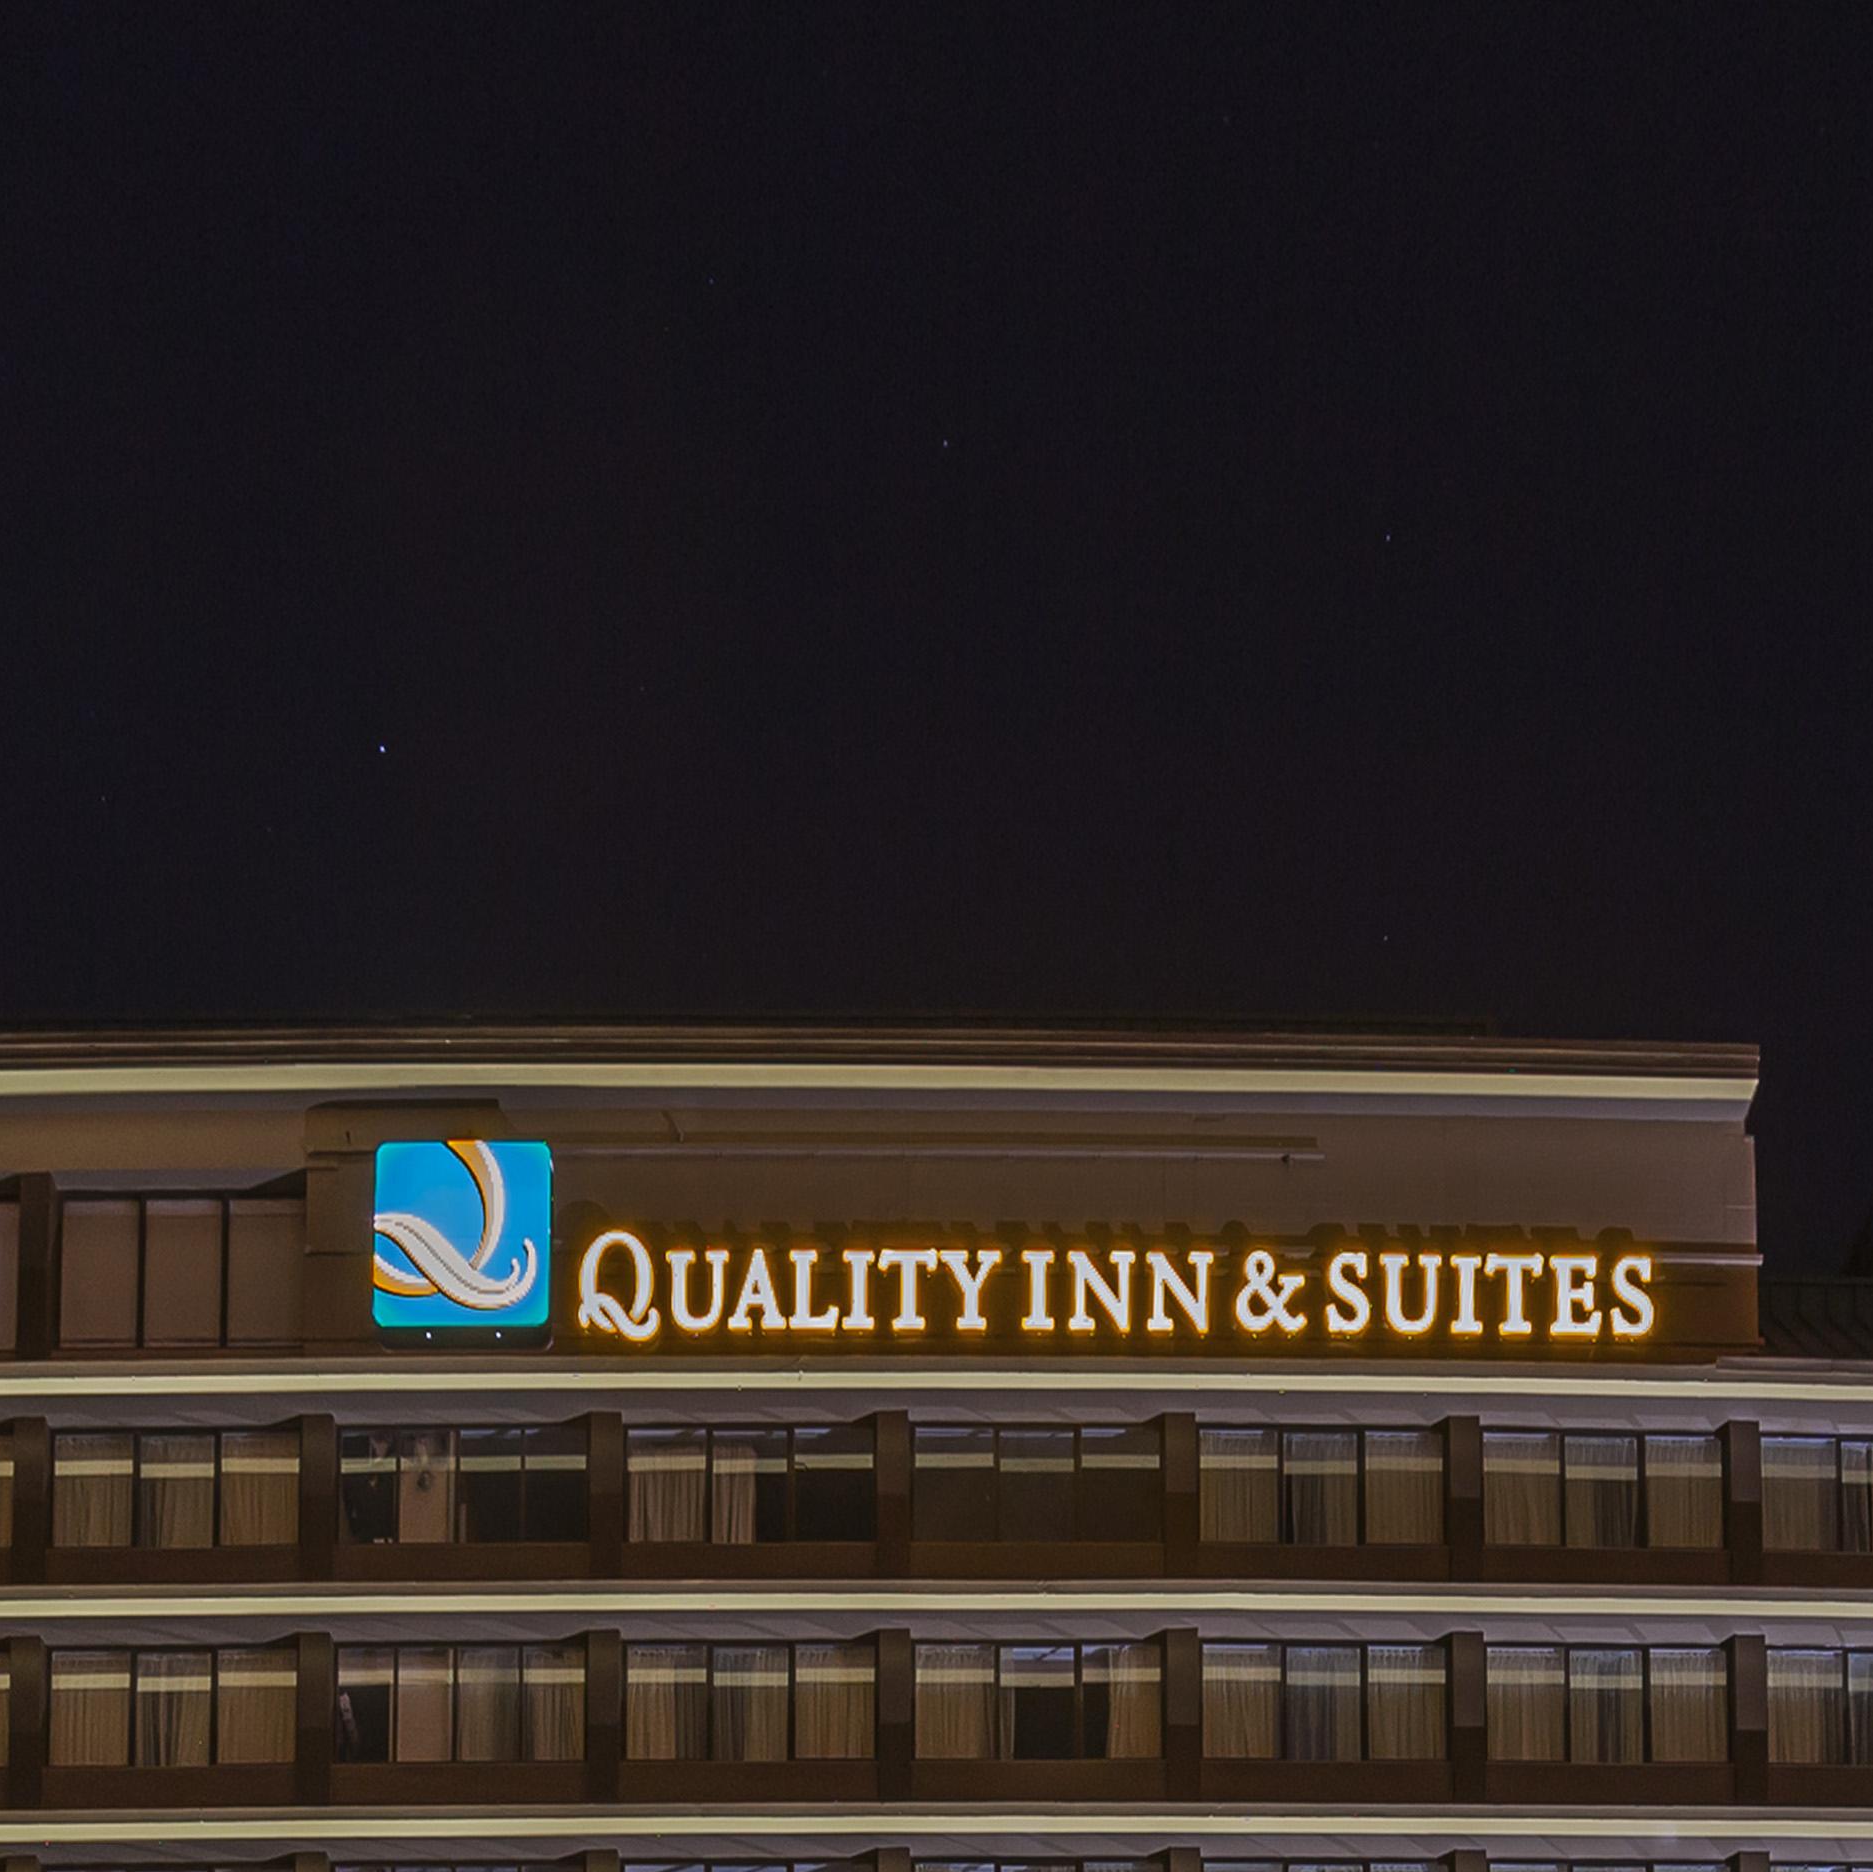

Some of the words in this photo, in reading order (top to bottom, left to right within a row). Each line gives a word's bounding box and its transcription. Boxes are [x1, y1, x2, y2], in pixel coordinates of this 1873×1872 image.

[578, 1231, 1002, 1340] QUALITY
[1022, 1250, 1214, 1332] INN
[1325, 1252, 1655, 1336] SUITES
